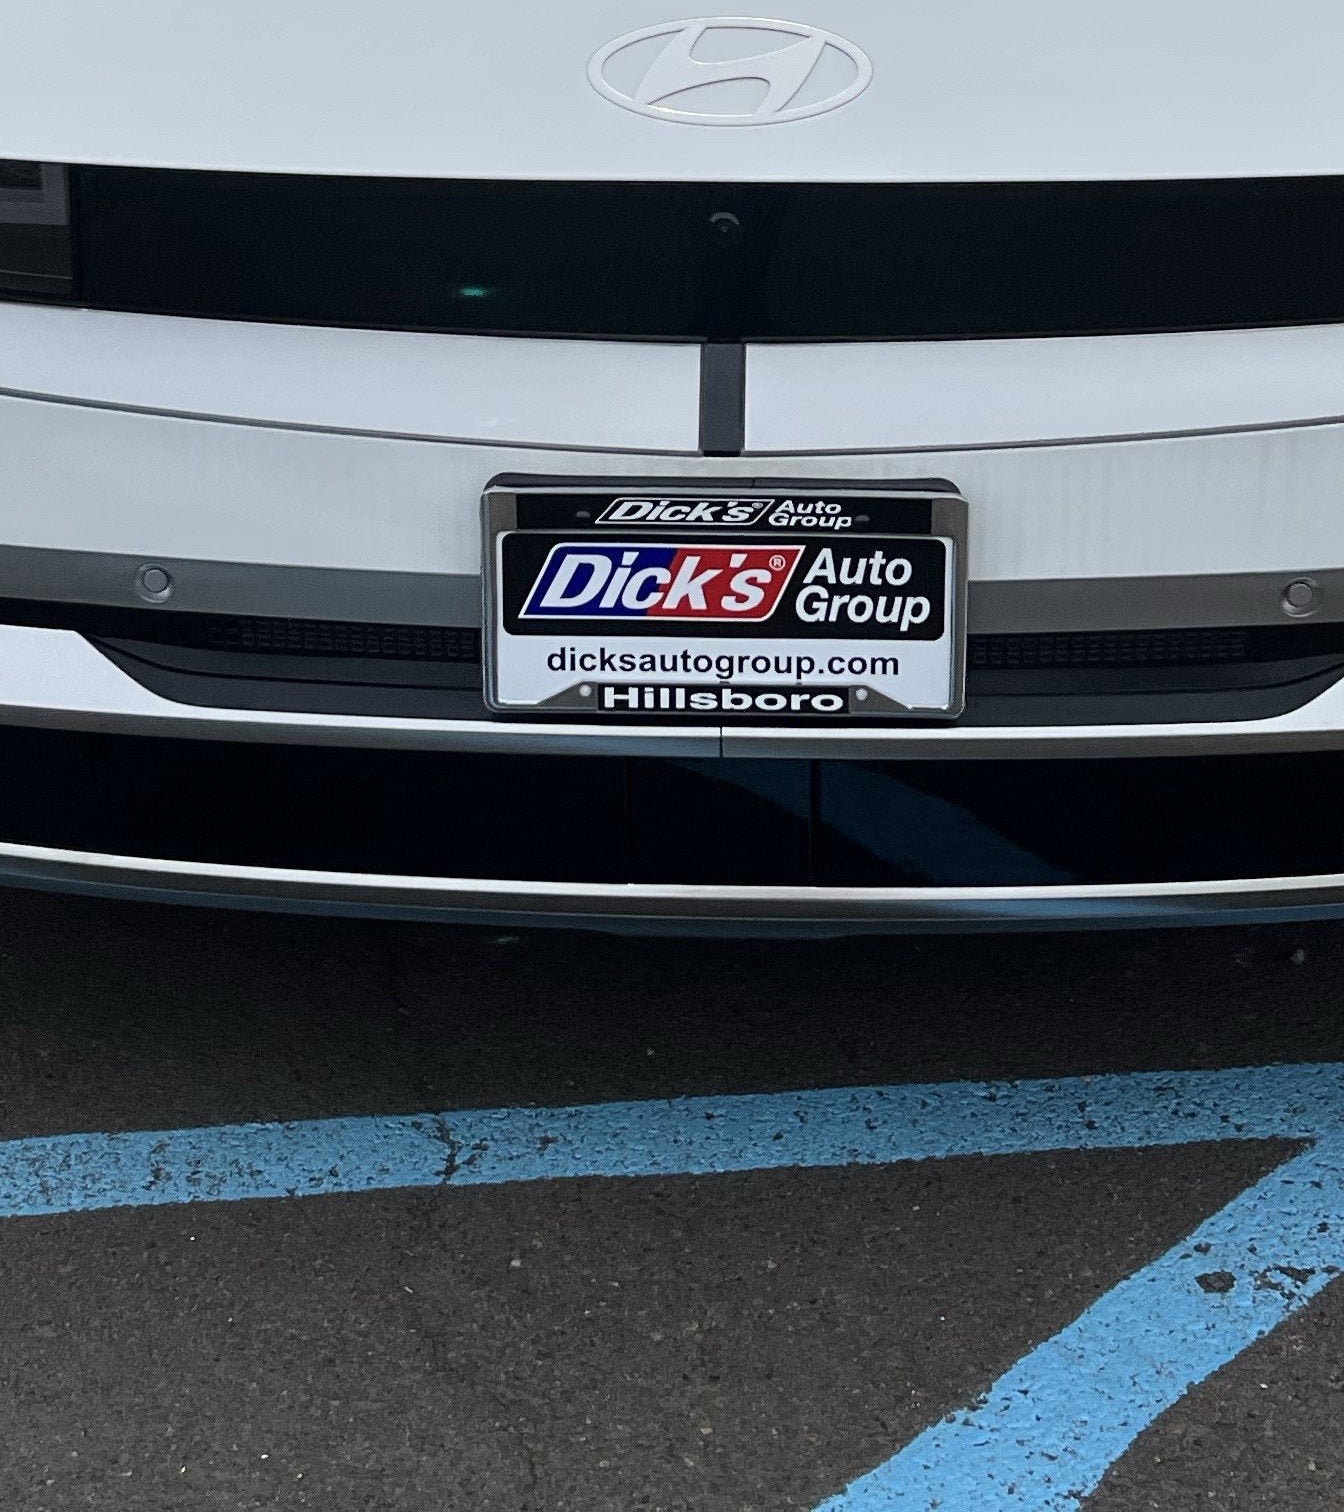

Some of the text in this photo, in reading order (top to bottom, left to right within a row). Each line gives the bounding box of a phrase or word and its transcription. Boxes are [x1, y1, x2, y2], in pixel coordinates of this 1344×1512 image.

[608, 500, 754, 522] Dick's
[768, 512, 852, 530] Group
[774, 499, 842, 514] Auto
[539, 550, 770, 613] Dick's
[803, 547, 913, 587] Auto
[795, 585, 931, 632] Group
[547, 647, 900, 680] dicksautogroup.com
[603, 686, 844, 712] Hillsboro
